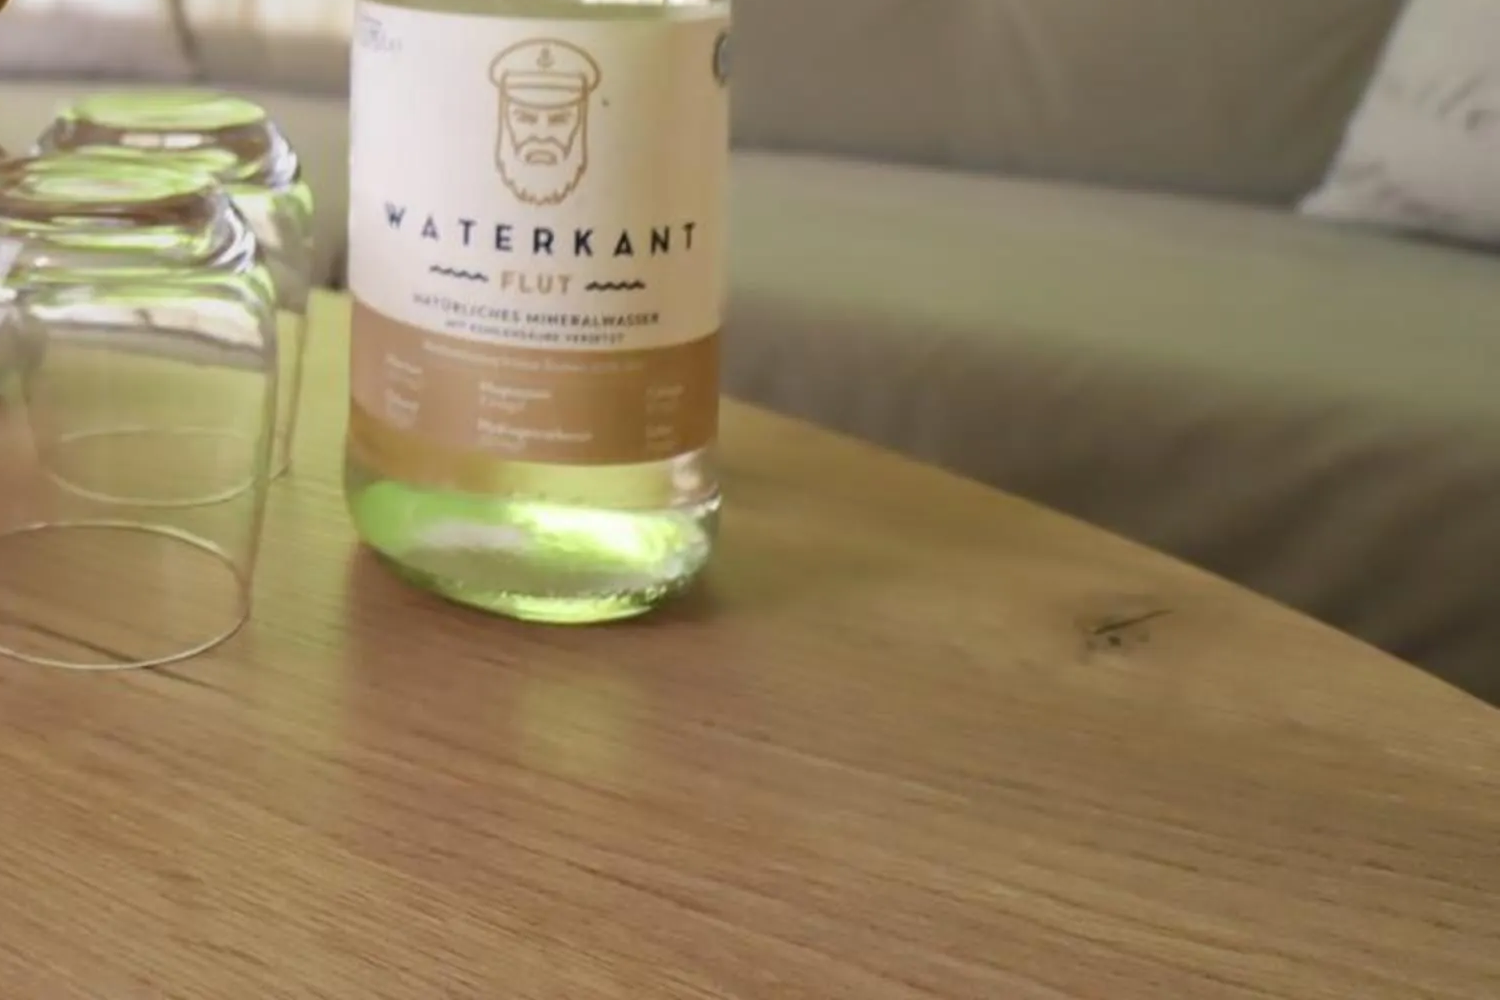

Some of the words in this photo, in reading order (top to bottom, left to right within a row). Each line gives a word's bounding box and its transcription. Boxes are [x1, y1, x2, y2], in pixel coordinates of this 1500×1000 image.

[385, 202, 696, 257] WATERKANT
[501, 271, 574, 295] FLUT
[414, 293, 521, 323] NATÜRLICHES
[526, 313, 659, 327] MINERALWASSER
